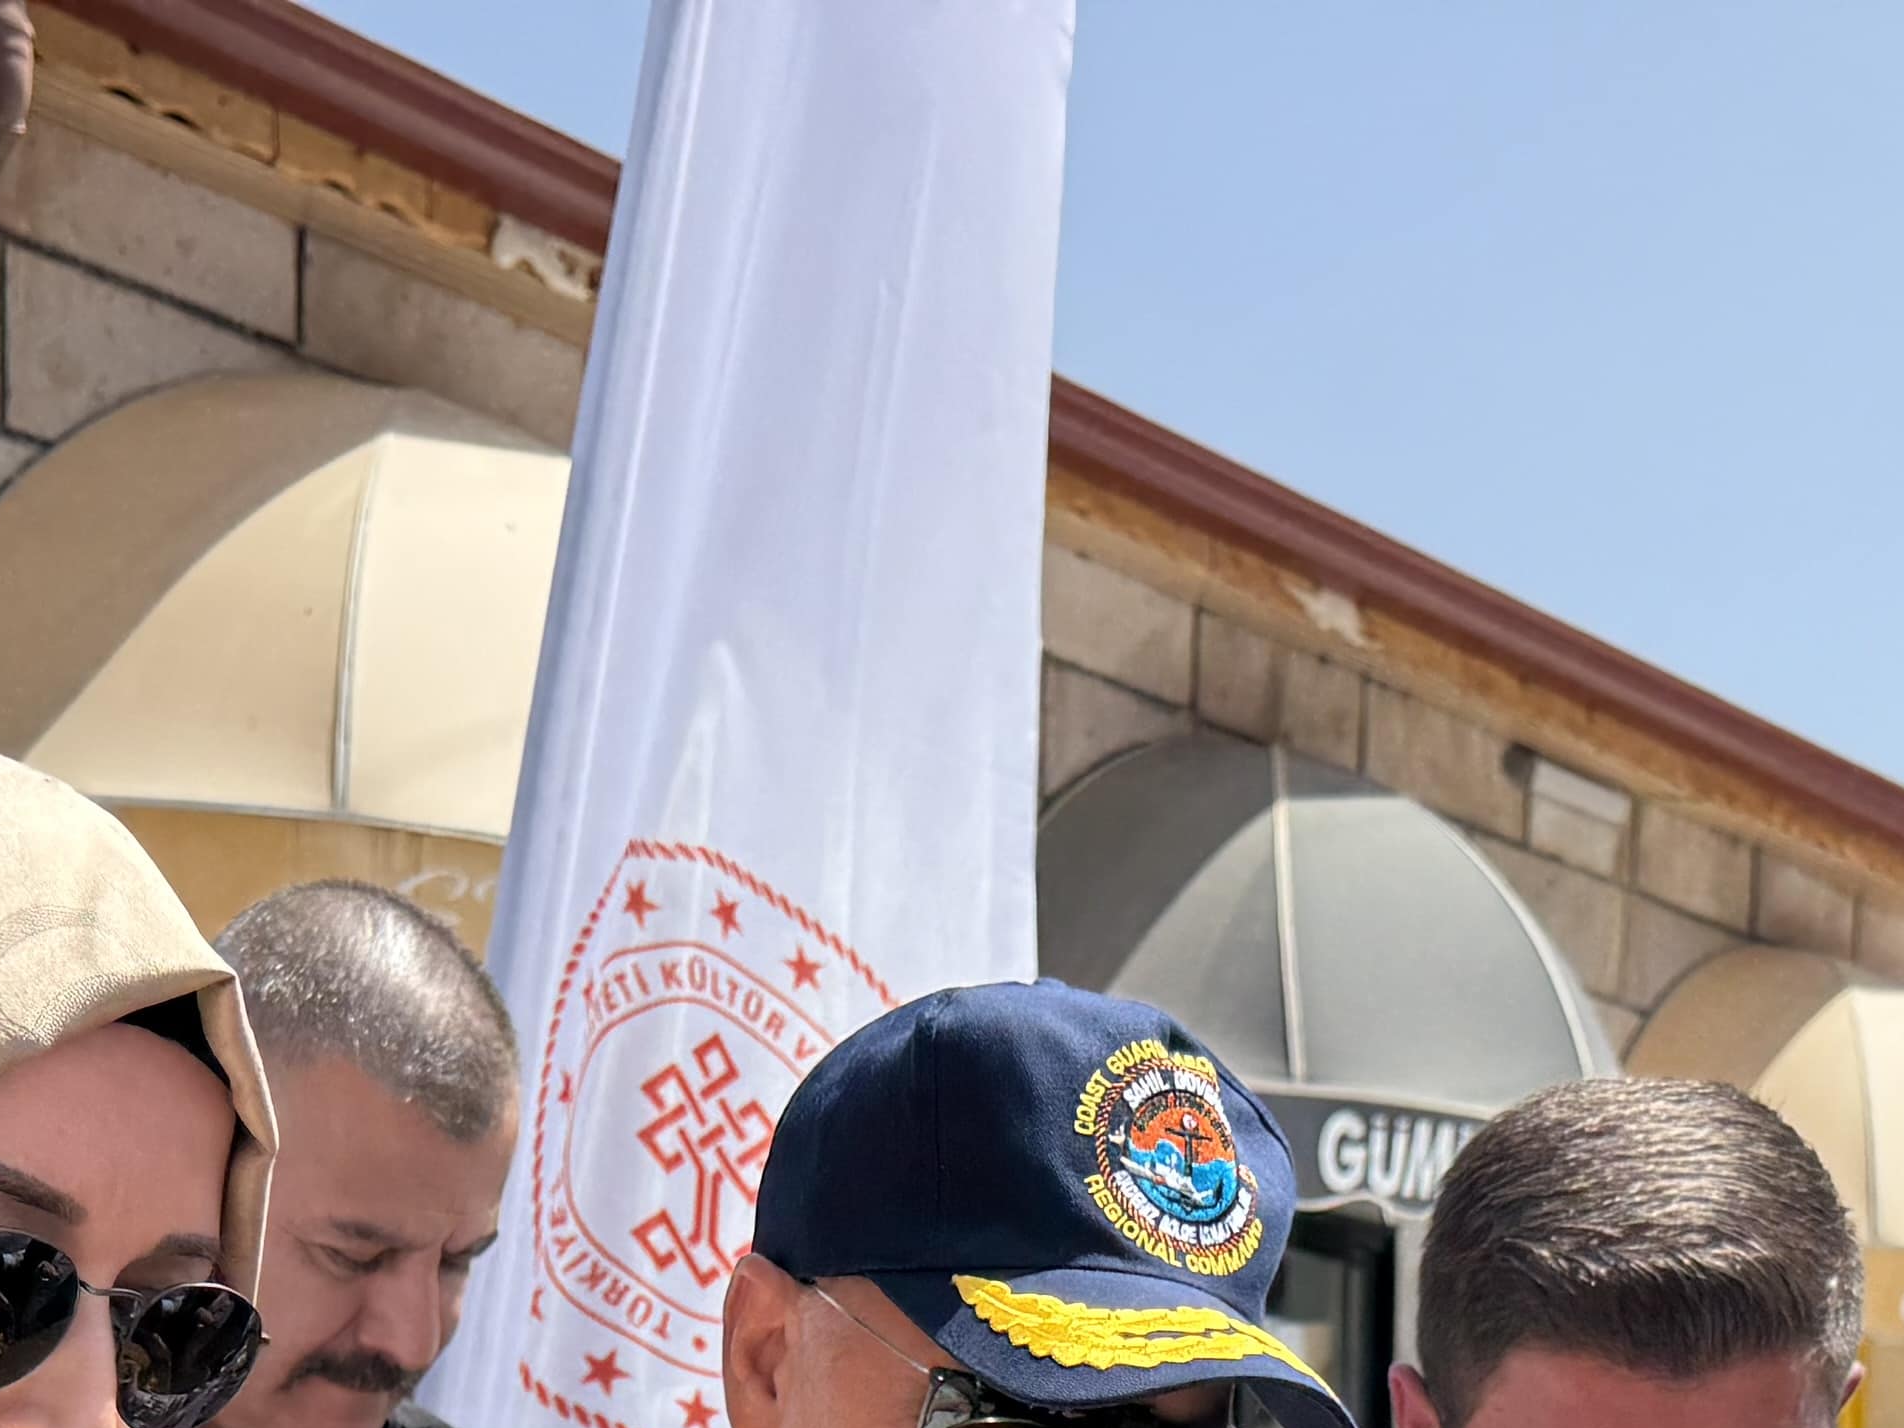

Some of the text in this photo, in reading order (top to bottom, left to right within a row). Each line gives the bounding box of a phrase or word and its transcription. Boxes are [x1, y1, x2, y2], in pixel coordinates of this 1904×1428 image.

[659, 955, 788, 1040] KÜLTÜR
[1074, 1069, 1113, 1136] COAST
[1084, 1173, 1264, 1277] REGIONAL COMMAND
